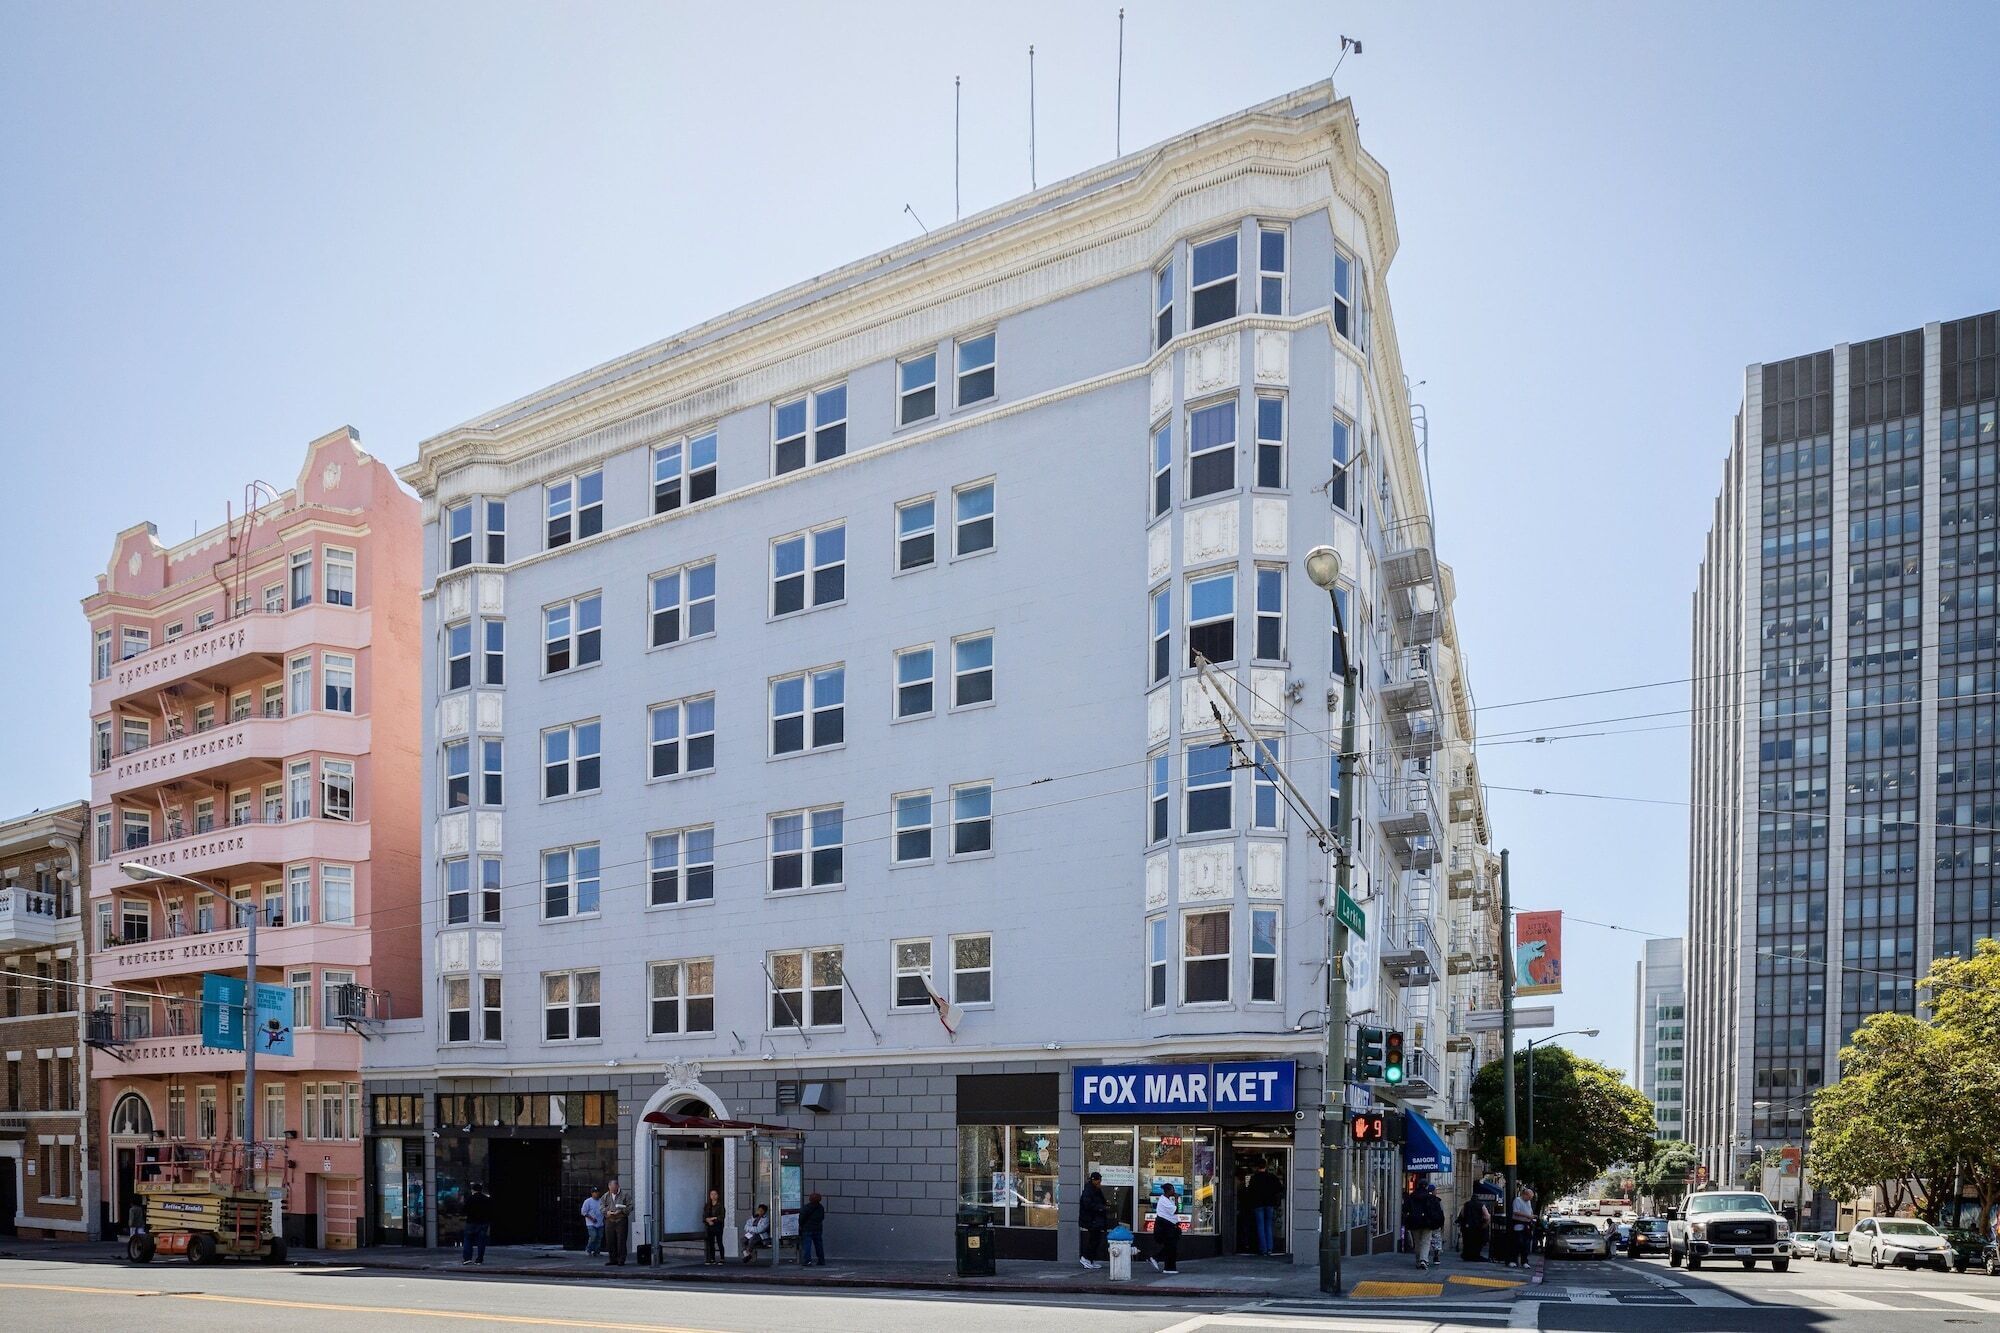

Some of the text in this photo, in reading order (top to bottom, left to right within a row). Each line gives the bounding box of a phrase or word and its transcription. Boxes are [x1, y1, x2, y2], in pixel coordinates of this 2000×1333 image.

[1342, 899, 1362, 931] Larkin
[1083, 1071, 1279, 1105] FOX MARKET
[1374, 1120, 1382, 1138] 9
[1162, 1137, 1181, 1145] ATM
[1407, 1163, 1439, 1171] SANDWICH
